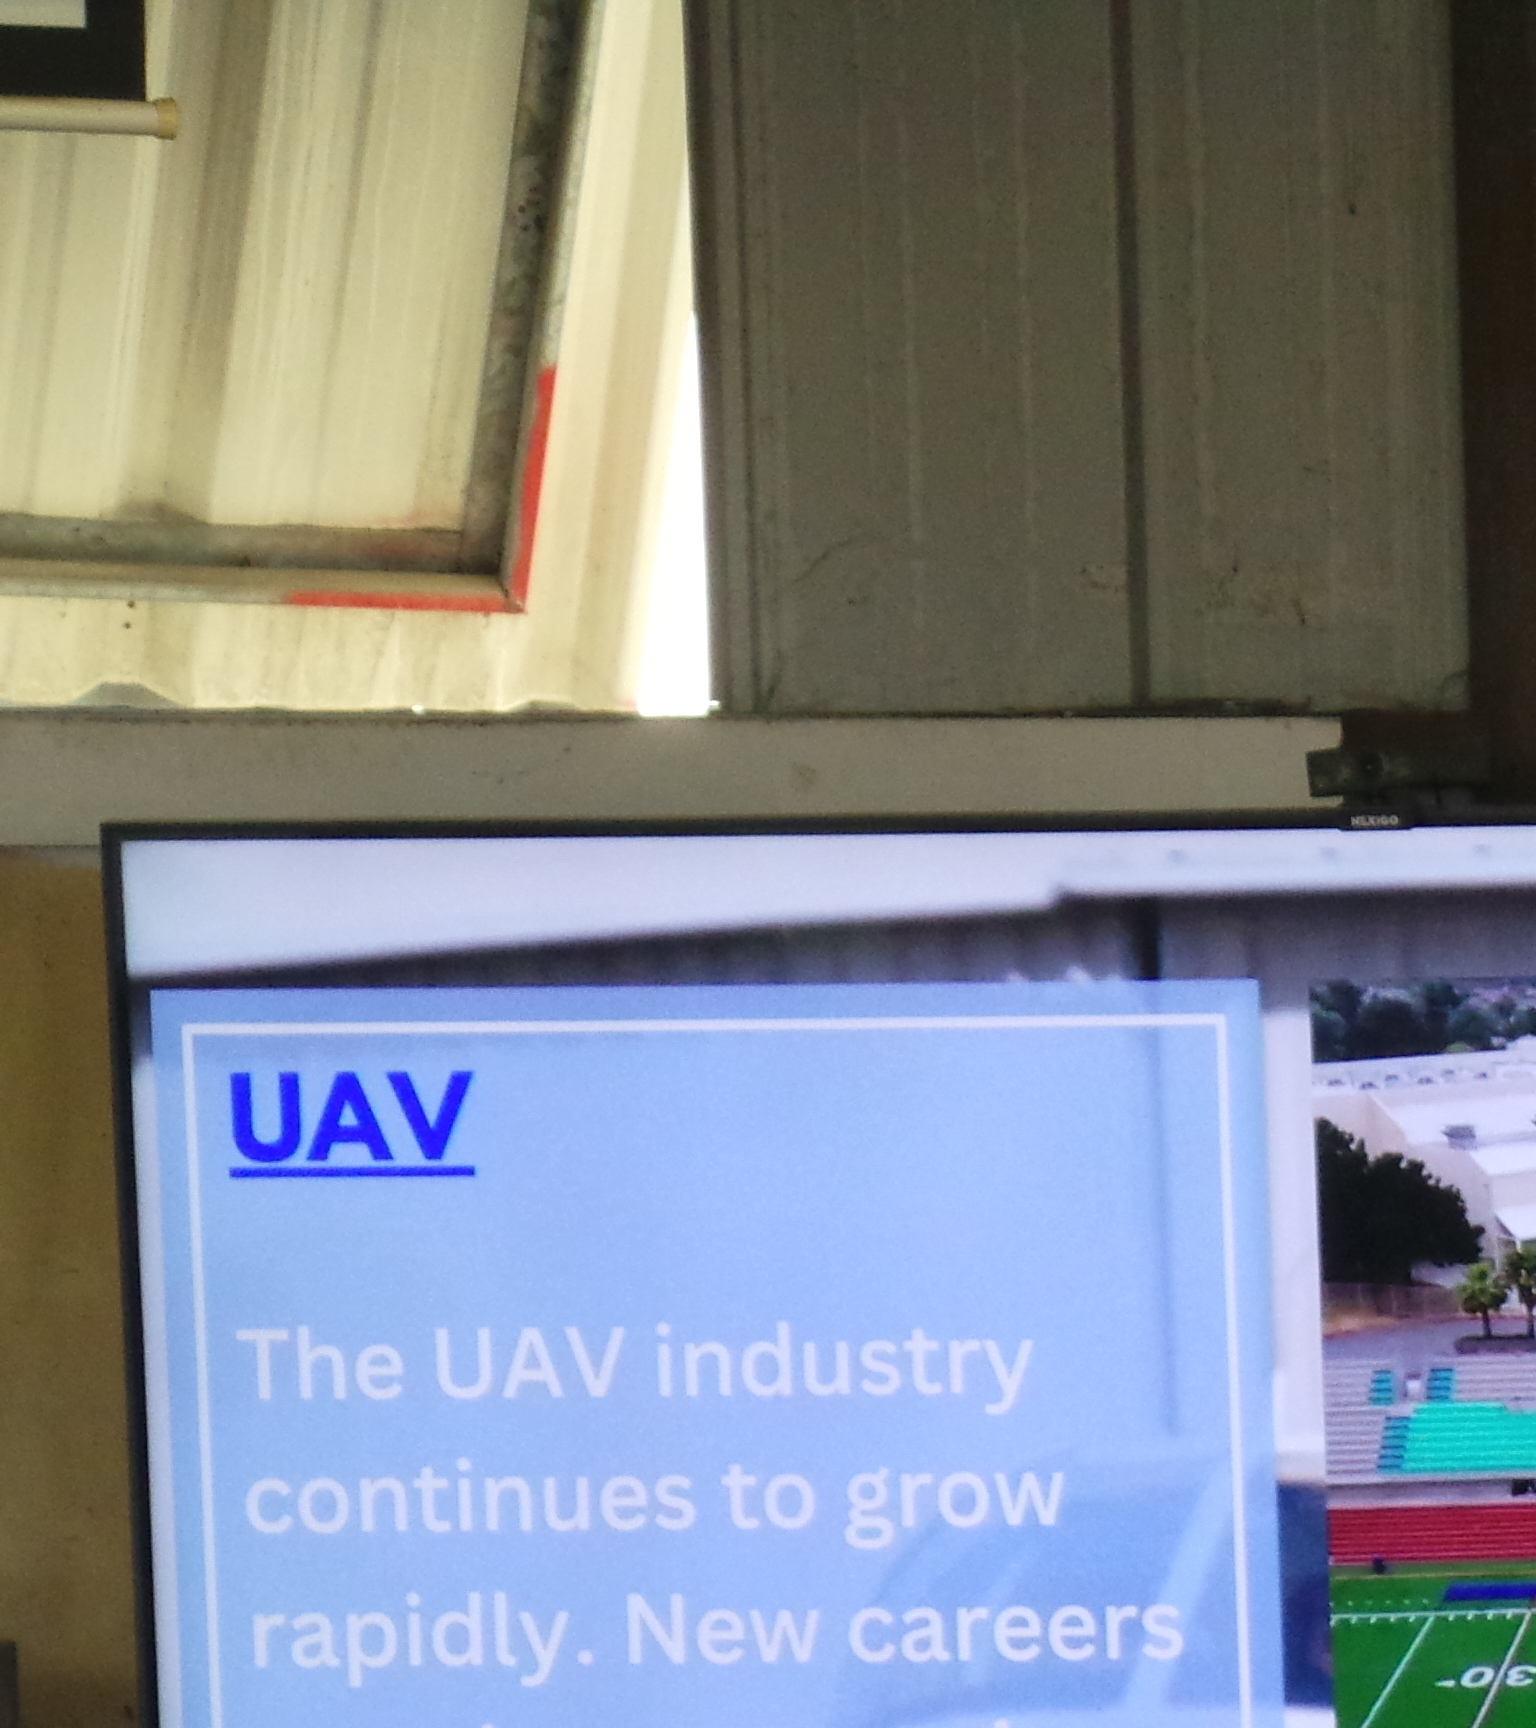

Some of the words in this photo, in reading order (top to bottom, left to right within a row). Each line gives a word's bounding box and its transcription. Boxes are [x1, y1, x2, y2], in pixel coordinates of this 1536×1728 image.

[228, 1070, 474, 1166] UAV
[236, 1326, 404, 1402] The
[435, 1326, 626, 1398] UAV
[655, 1321, 1034, 1416] industry
[244, 1459, 697, 1535] continues
[721, 1468, 816, 1531] to
[844, 1464, 1066, 1550] grow
[252, 1591, 596, 1688] rapidly.
[627, 1593, 819, 1666] New
[848, 1600, 1185, 1664] careers
